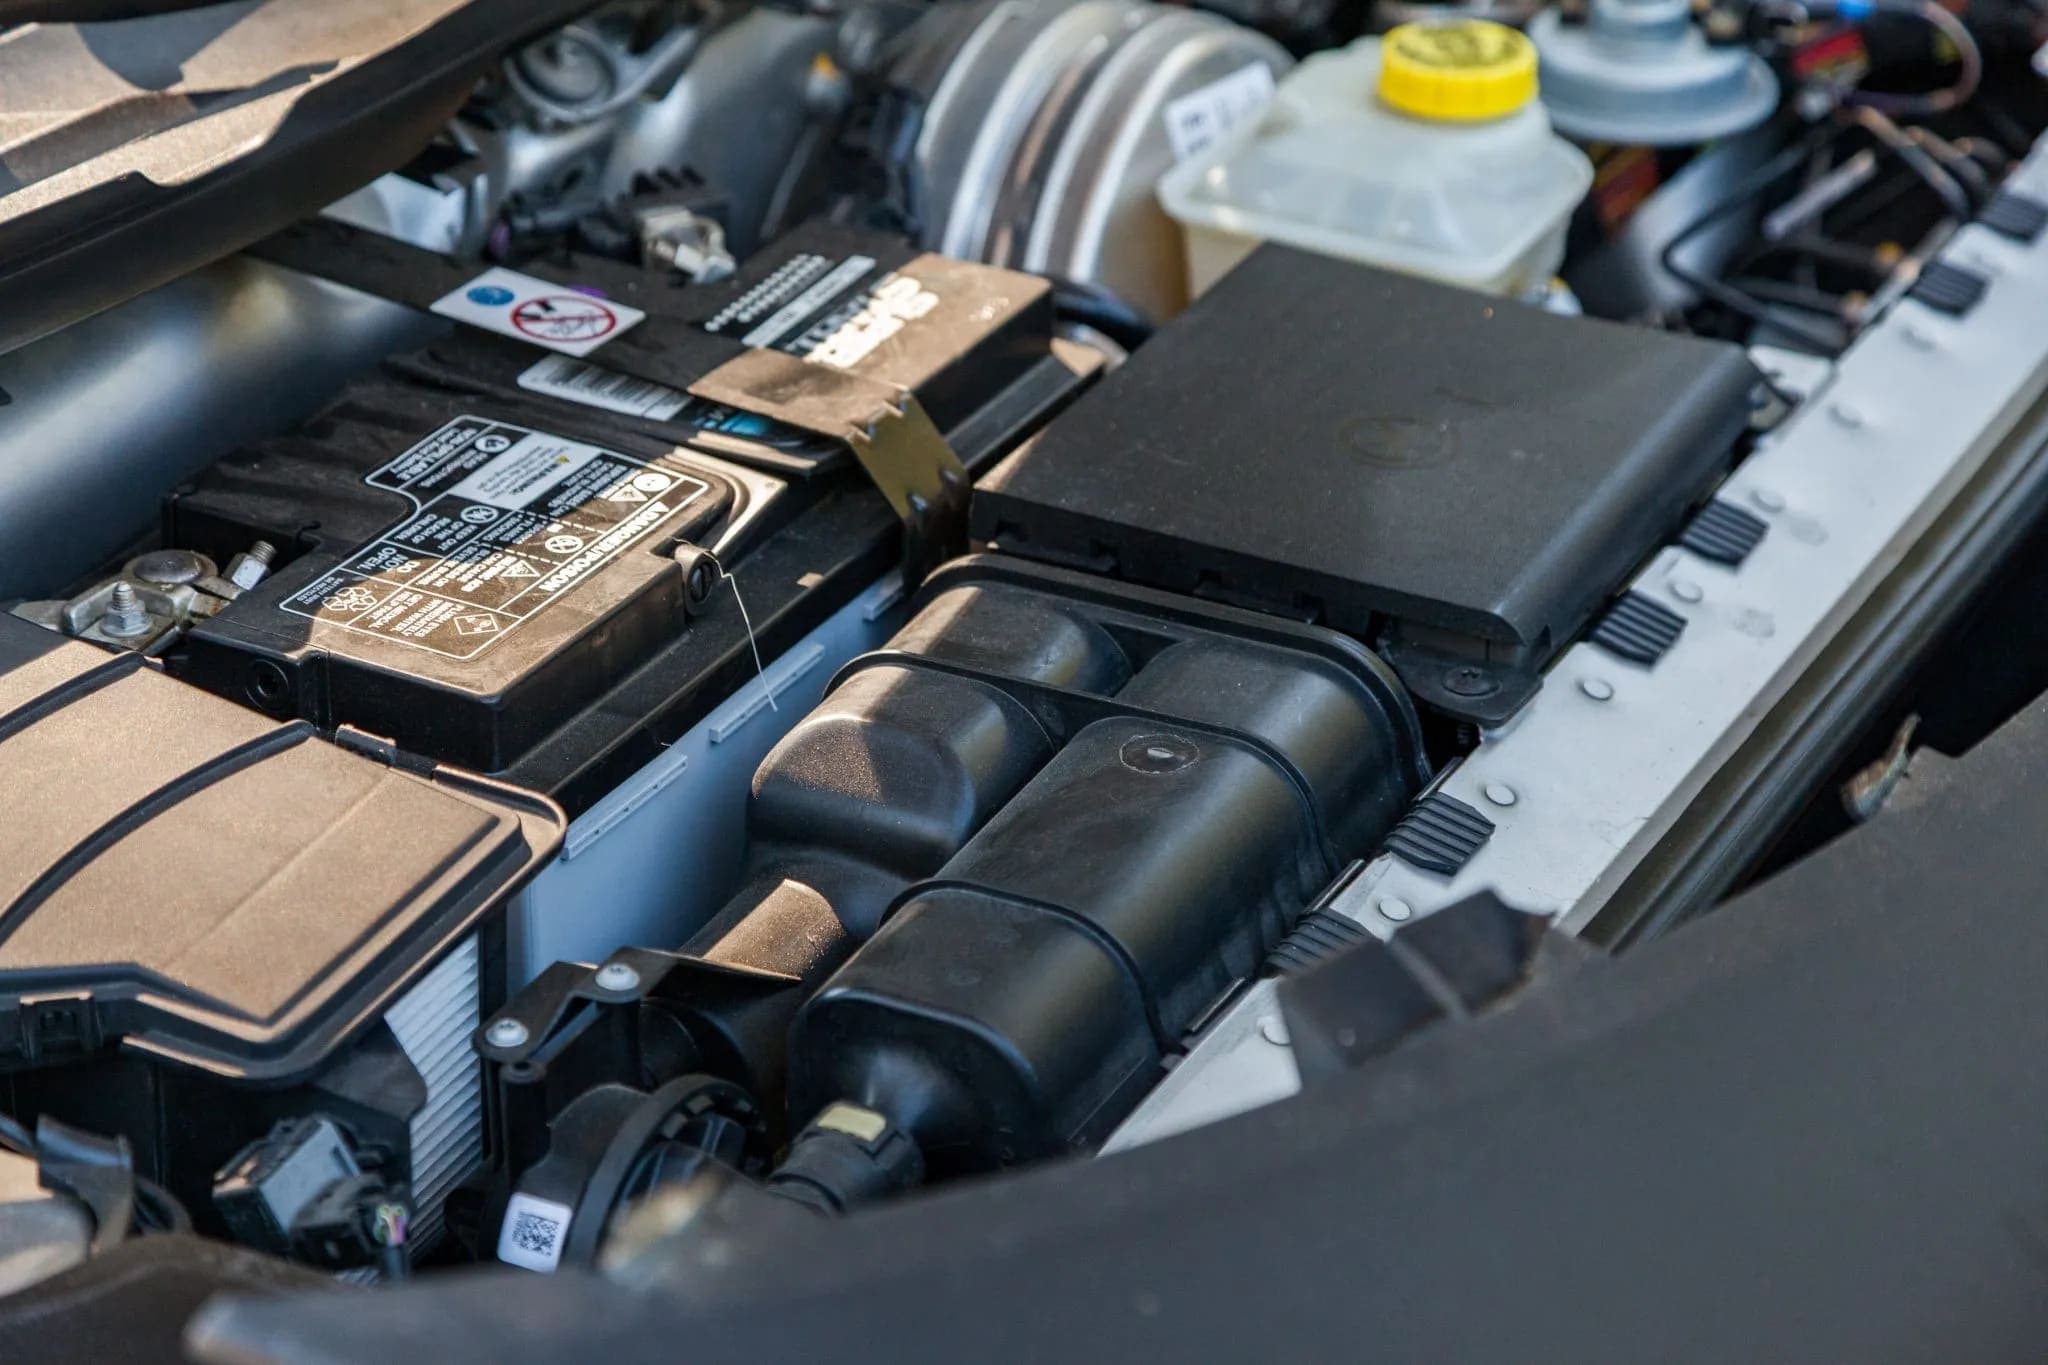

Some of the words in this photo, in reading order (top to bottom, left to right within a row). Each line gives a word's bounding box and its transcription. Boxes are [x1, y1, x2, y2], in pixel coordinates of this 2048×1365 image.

[354, 545, 399, 572] OPEN.
[536, 509, 662, 592] DANGER/POISON
[374, 553, 410, 572] NOT
[393, 559, 422, 574] DO
